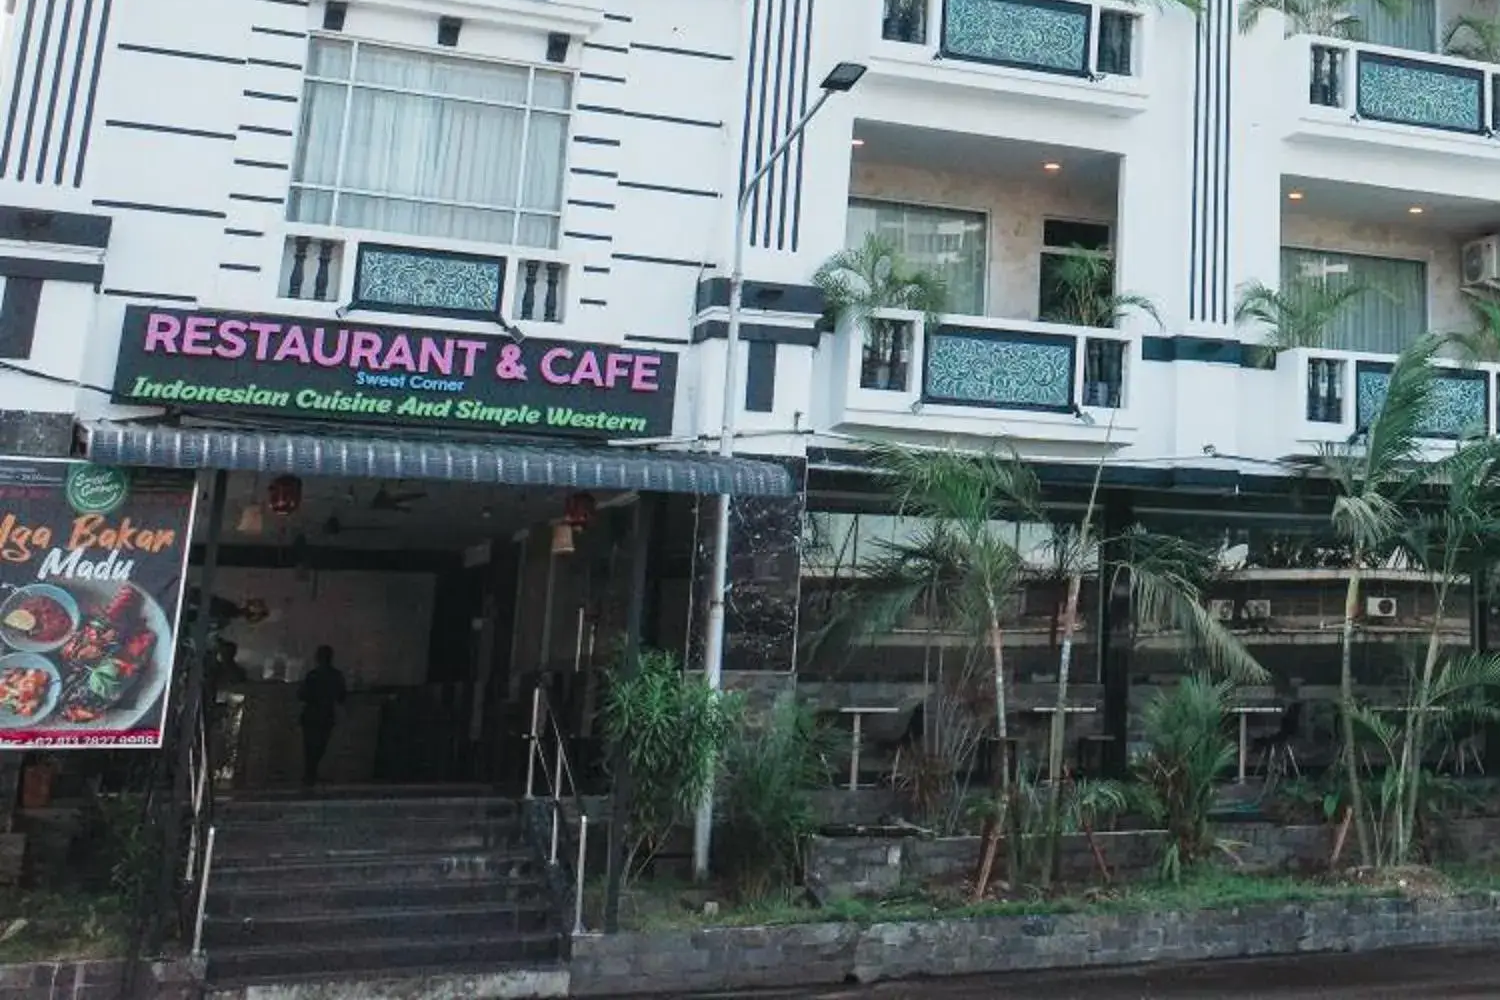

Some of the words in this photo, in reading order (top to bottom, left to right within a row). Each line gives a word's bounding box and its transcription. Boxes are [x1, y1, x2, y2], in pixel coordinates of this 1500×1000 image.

[144, 312, 488, 377] RESTAURANT
[496, 343, 528, 381] &
[540, 347, 662, 391] CAFE
[356, 370, 405, 389] Sweet
[409, 375, 465, 393] Corner
[131, 375, 290, 408] Indonesian
[295, 388, 392, 415] Cuisine
[397, 395, 453, 419] And
[454, 400, 542, 428] Simple
[546, 406, 649, 433] Western
[68, 513, 176, 554] Bakar
[37, 547, 136, 581] Madu
